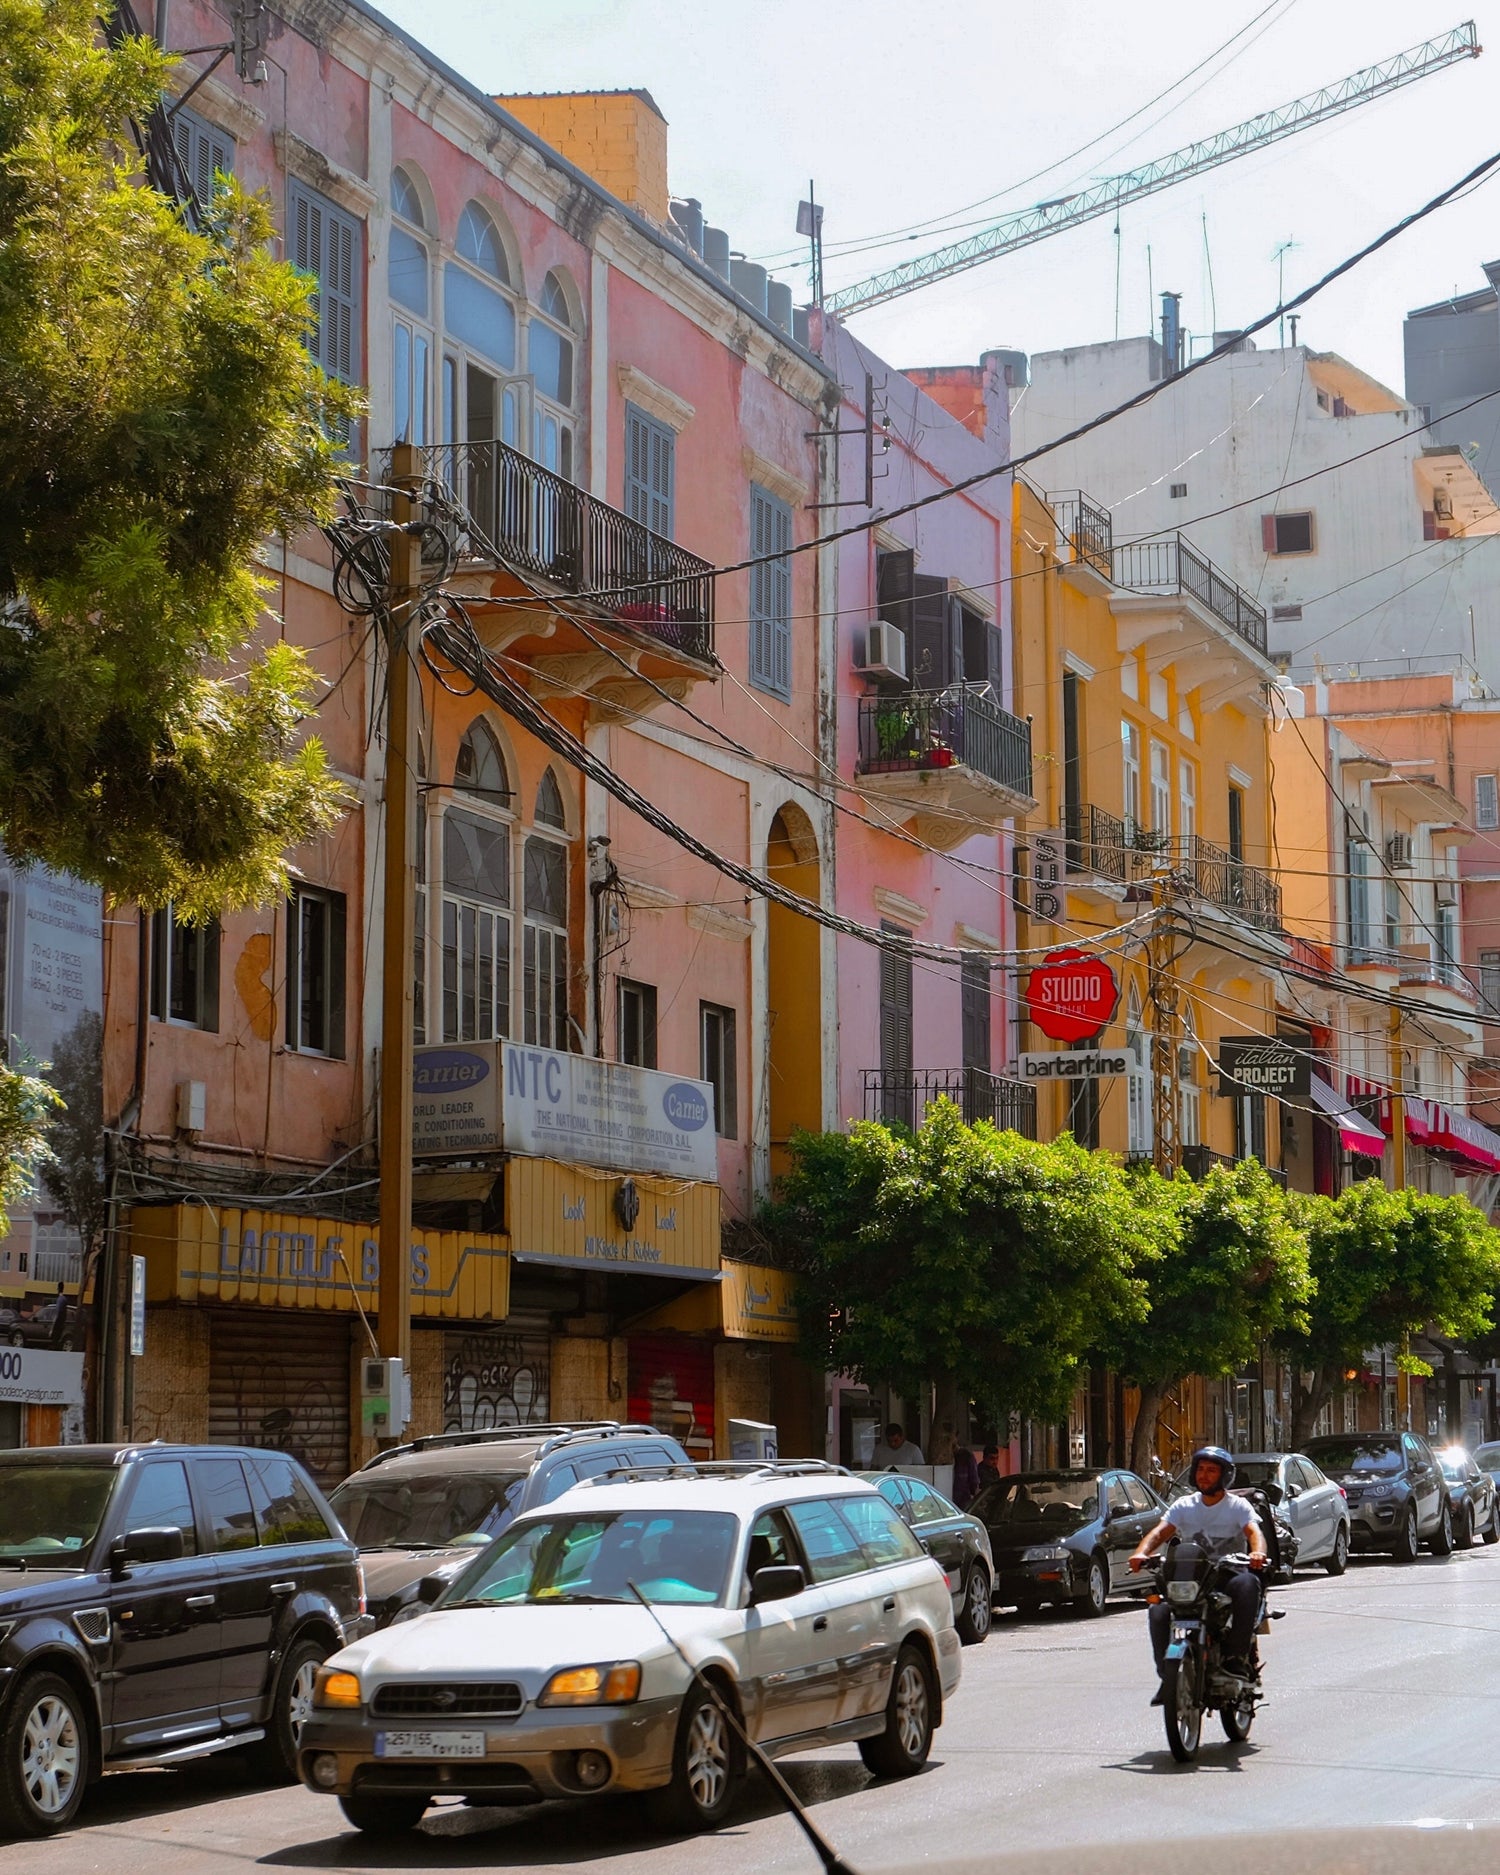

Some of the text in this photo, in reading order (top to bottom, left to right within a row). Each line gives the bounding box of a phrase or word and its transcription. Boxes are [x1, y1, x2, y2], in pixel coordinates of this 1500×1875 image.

[1036, 838, 1058, 919] SUD
[32, 943, 41, 956] 70
[1042, 976, 1101, 1002] STUDIO
[508, 1048, 562, 1103] NTC
[1025, 1055, 1126, 1077] bartartine
[1233, 1067, 1297, 1085] PROJECT
[413, 1102, 474, 1117] ORLD LEADER
[668, 1092, 705, 1121] Carrier
[424, 1117, 486, 1132] CONDITIONING
[536, 1109, 552, 1126] THE
[556, 1112, 592, 1133] NATIONAL
[594, 1118, 624, 1138] TRADING
[628, 1124, 674, 1146] CORPORATION
[413, 1132, 499, 1150] EATING TECHNOLOGY
[362, 1238, 429, 1285] BS
